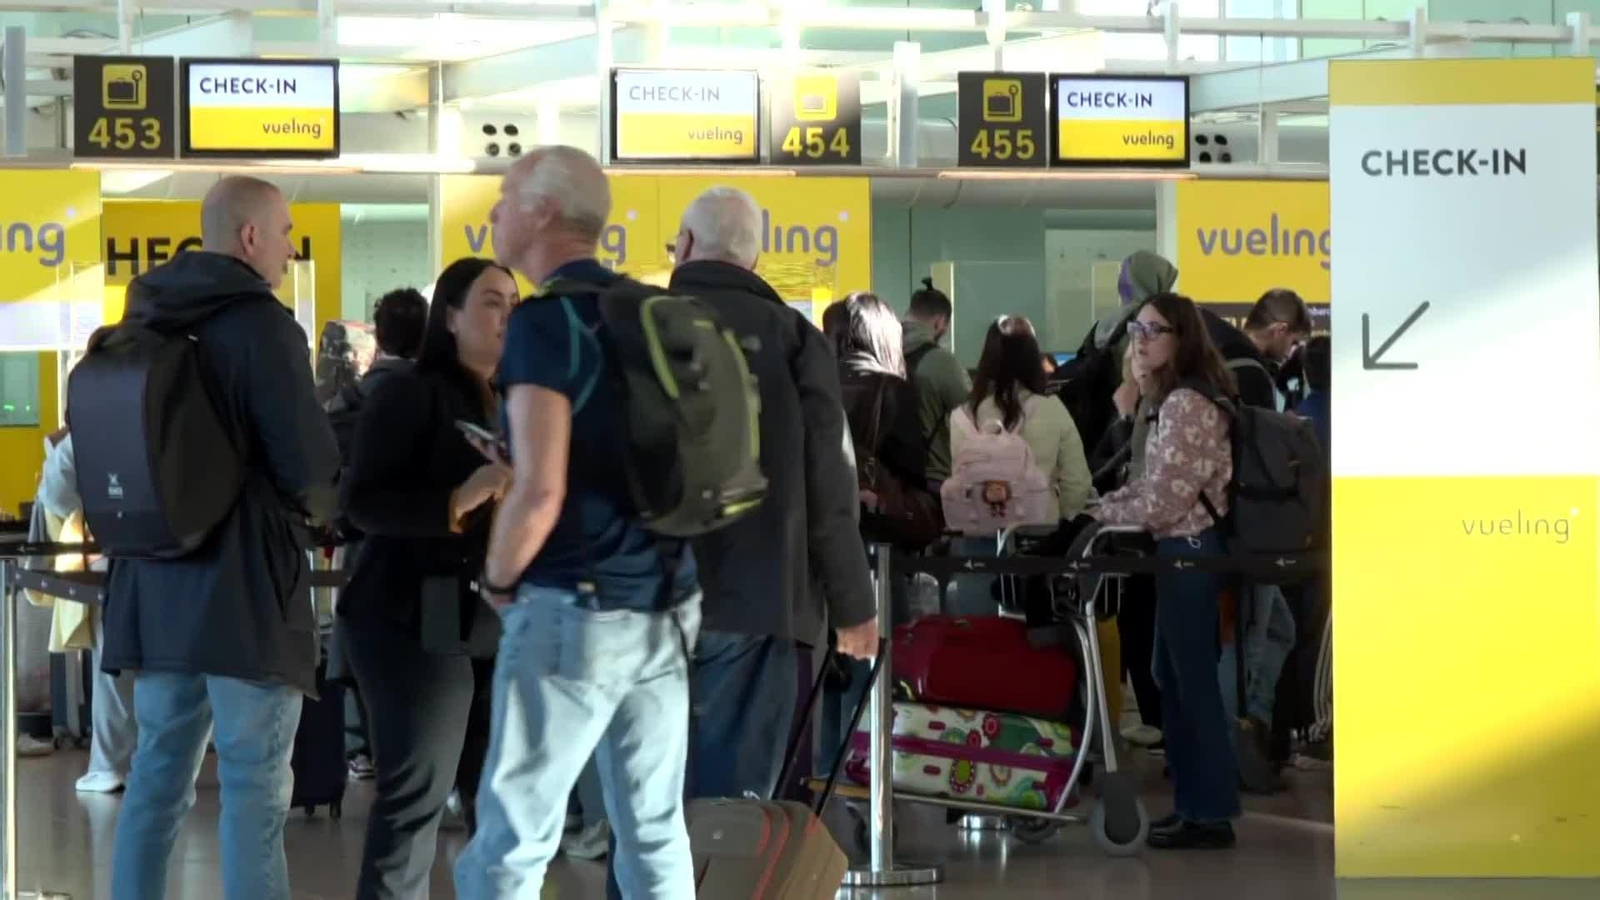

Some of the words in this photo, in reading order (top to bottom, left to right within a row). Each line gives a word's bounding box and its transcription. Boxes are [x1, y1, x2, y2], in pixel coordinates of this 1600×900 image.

[199, 77, 297, 94] CHECK-IN
[628, 85, 721, 101] CHECK-IN
[1066, 91, 1153, 108] CHECK-IN
[88, 117, 162, 149] 453
[262, 118, 322, 138] vueling
[687, 127, 744, 145] vueling
[1122, 132, 1174, 149] vueling
[781, 128, 850, 158] 454
[970, 129, 1035, 160] 455
[1361, 148, 1526, 176] CHECK-IN
[0, 222, 65, 267] ng
[762, 209, 838, 267] ling
[1462, 508, 1569, 544] vueling
